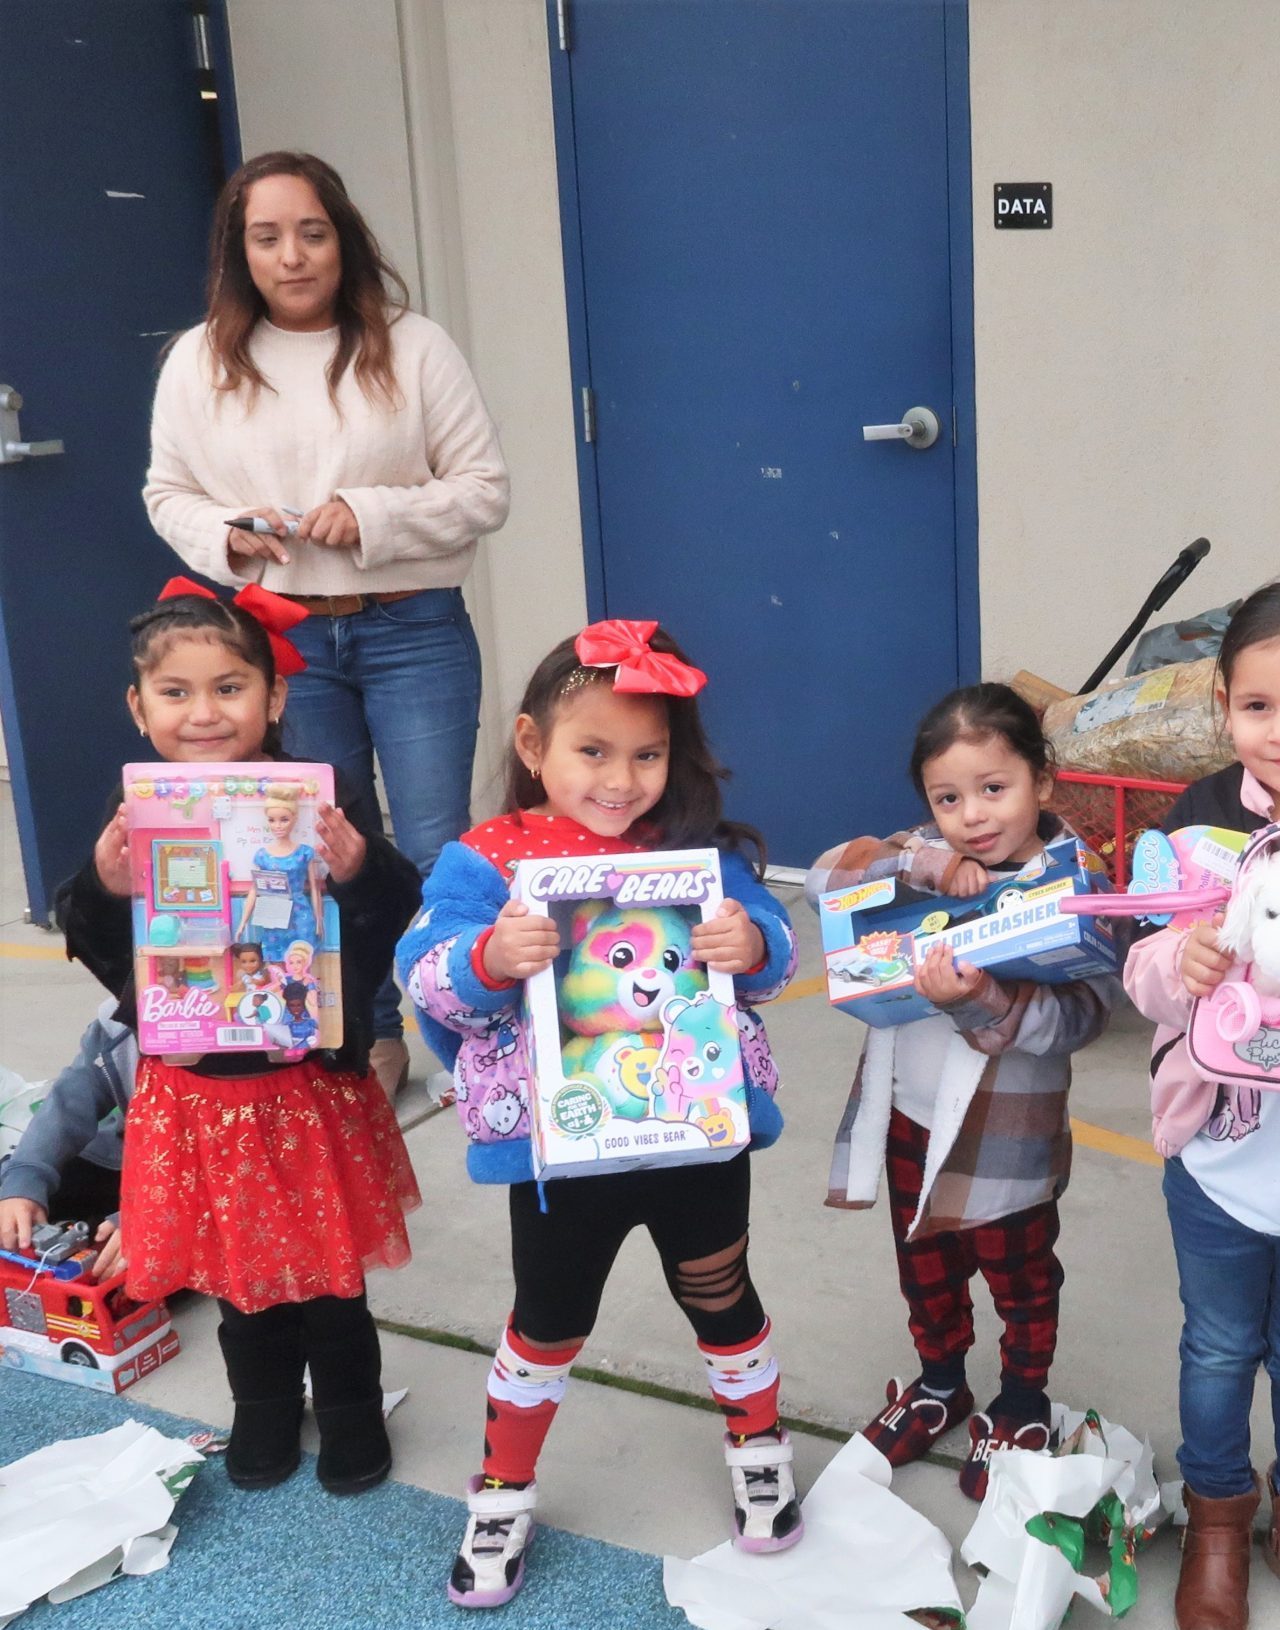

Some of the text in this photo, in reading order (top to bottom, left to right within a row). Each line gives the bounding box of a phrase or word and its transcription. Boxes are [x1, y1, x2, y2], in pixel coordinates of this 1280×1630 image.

[998, 198, 1046, 214] DATA
[530, 864, 713, 904] CARE BEARS
[920, 926, 974, 960] COR
[979, 901, 1059, 940] CRASHER
[143, 986, 220, 1023] Barbie
[604, 1130, 687, 1149] GOOD VIBES BEAR
[879, 1404, 907, 1432] LIL
